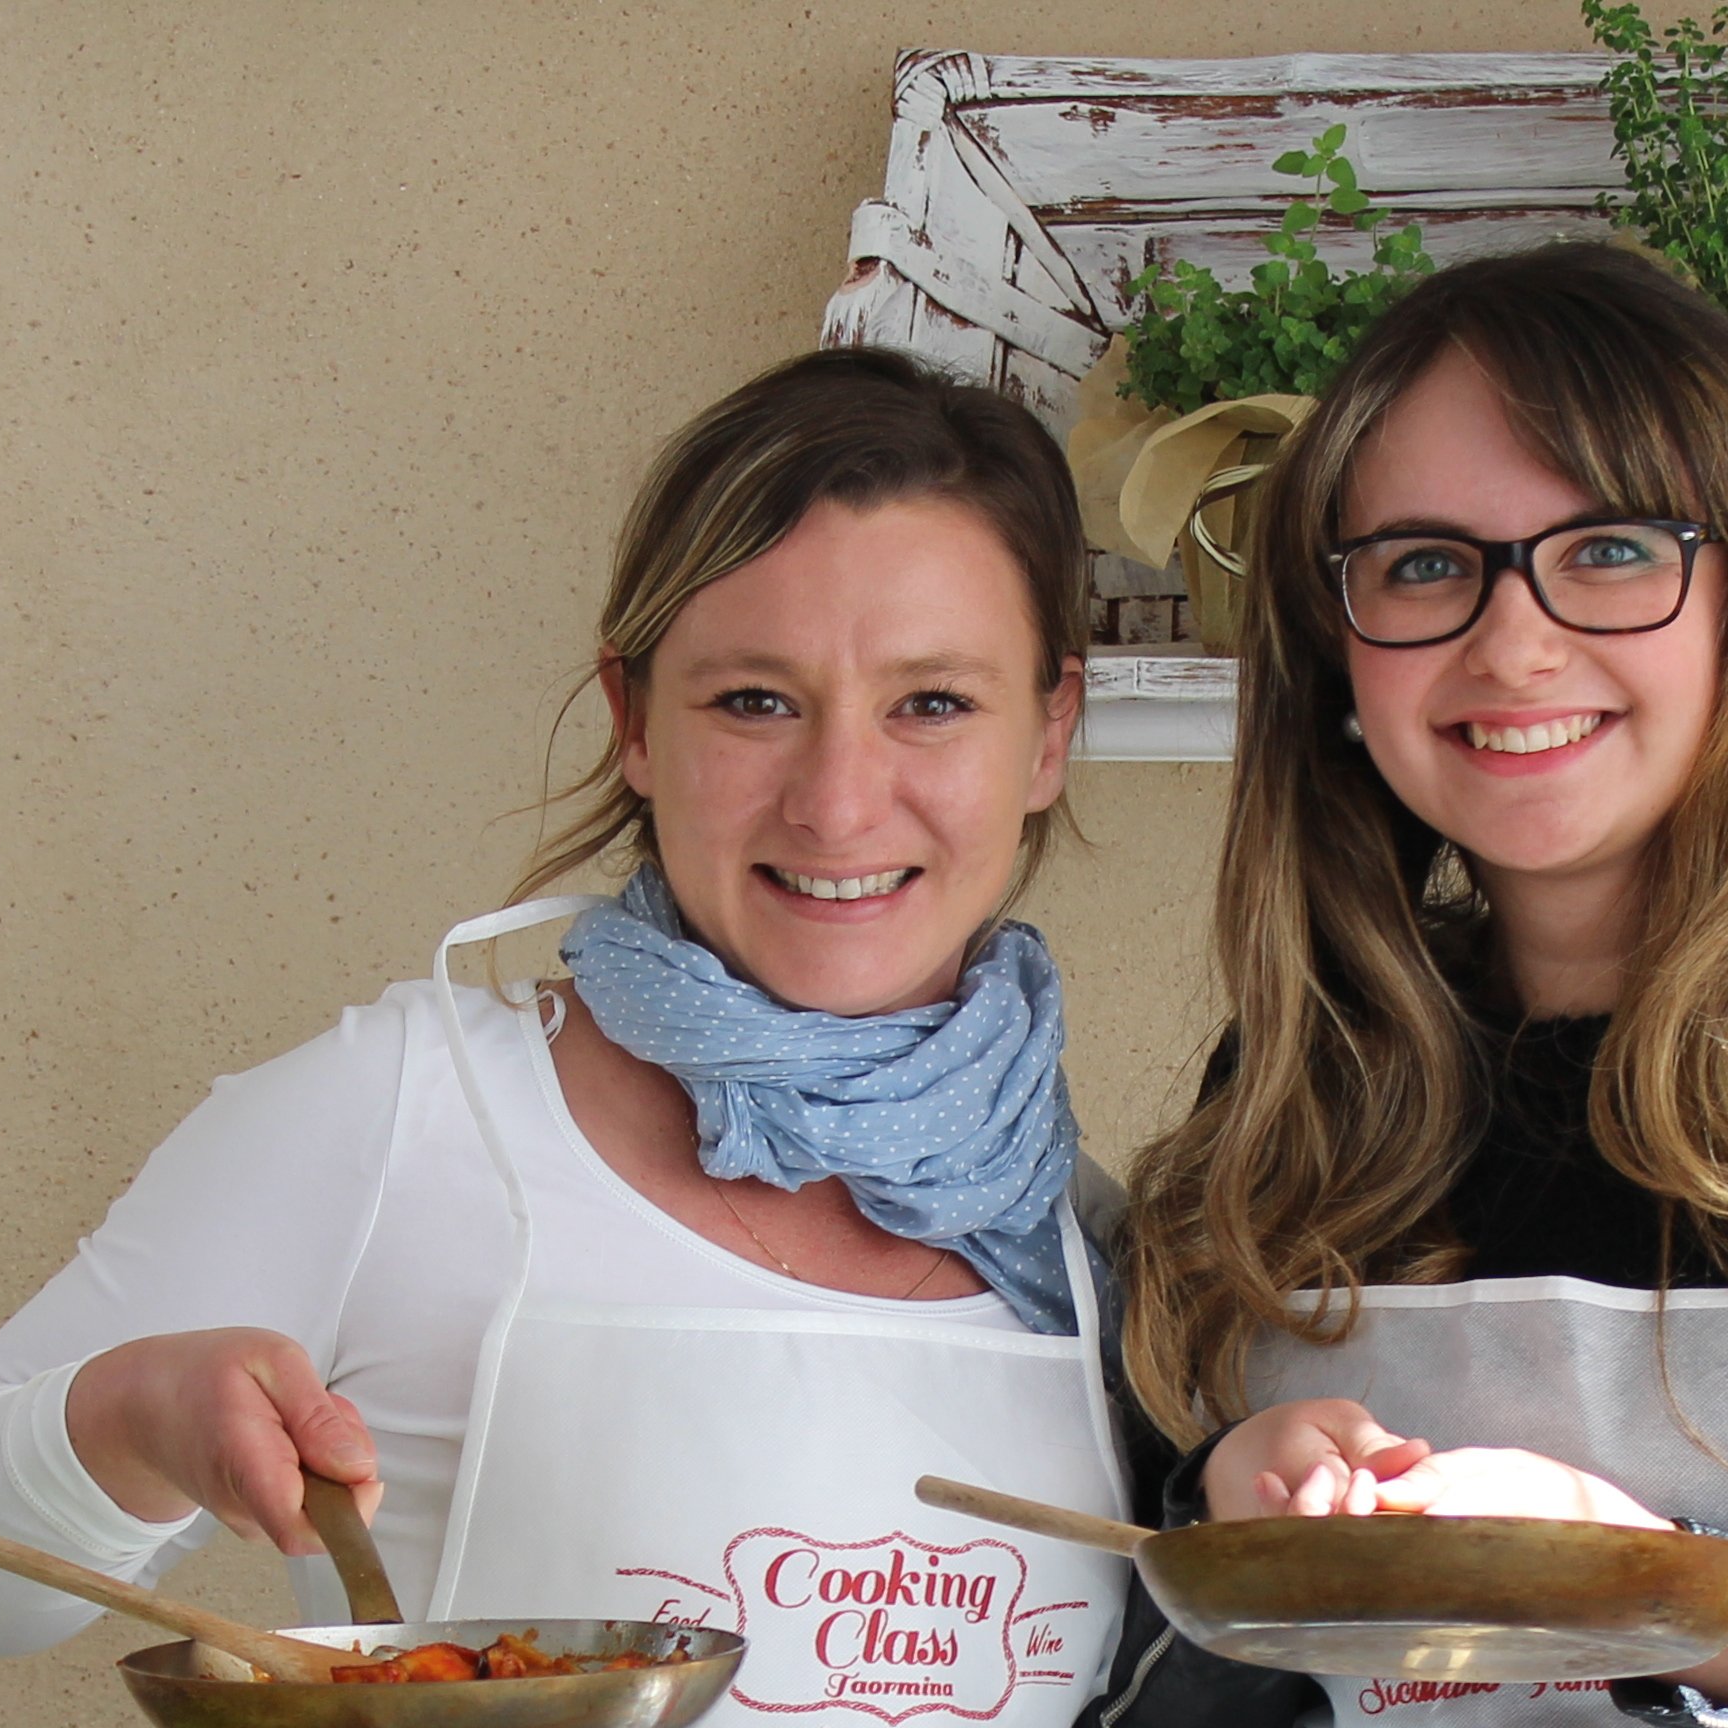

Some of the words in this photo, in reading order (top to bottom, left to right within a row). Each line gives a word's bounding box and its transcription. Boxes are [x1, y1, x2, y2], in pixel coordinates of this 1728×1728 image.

[764, 1548, 998, 1623] Cooking
[814, 1608, 959, 1670] Class
[1025, 1623, 1065, 1658] Wine
[824, 1672, 954, 1699] Taormina
